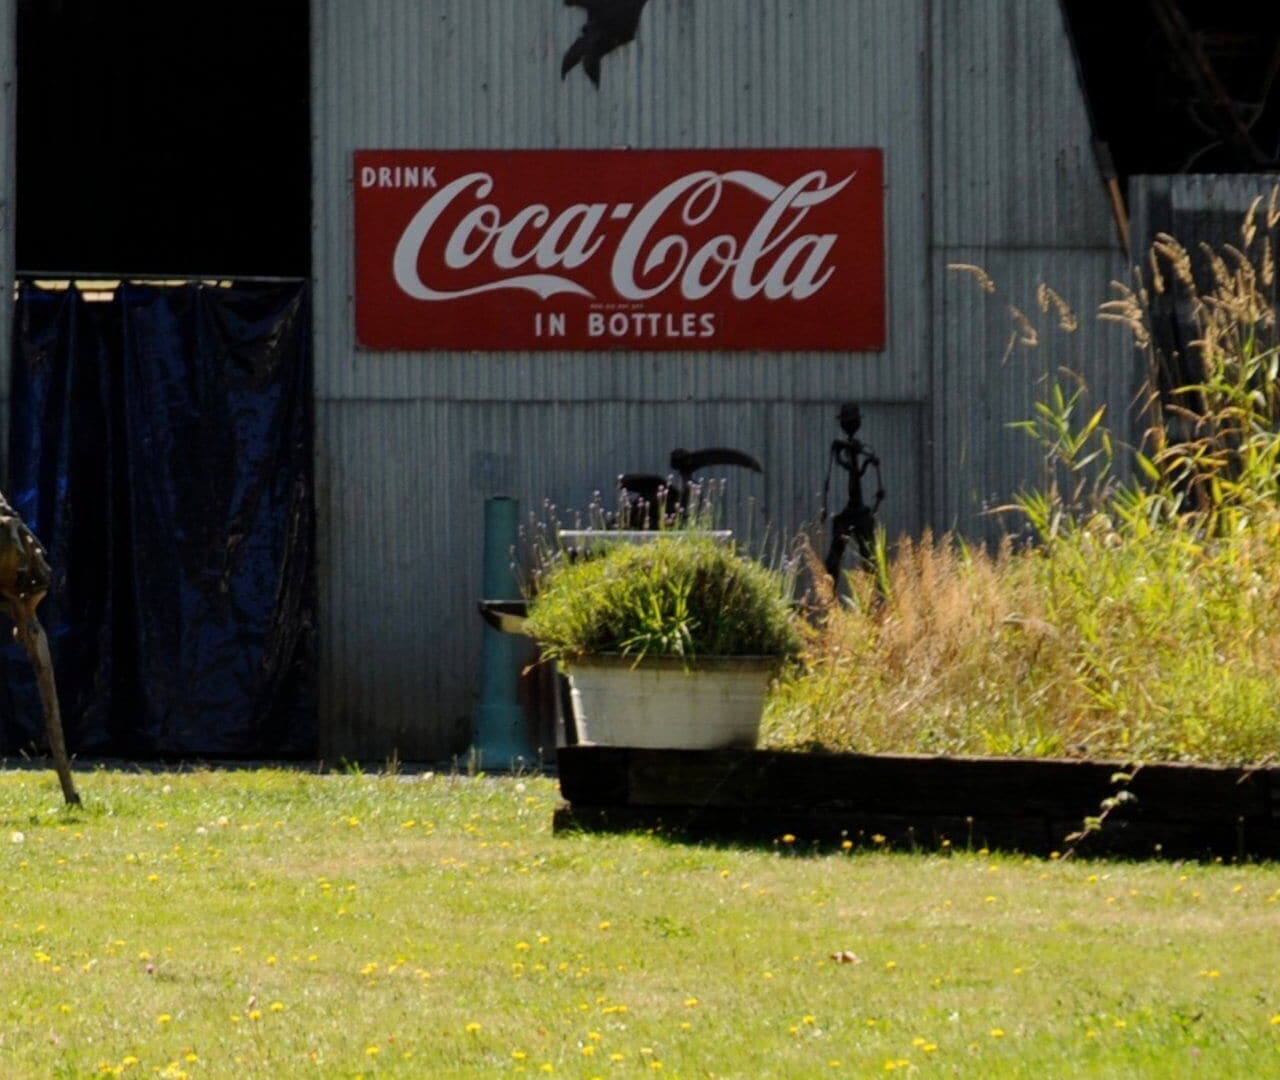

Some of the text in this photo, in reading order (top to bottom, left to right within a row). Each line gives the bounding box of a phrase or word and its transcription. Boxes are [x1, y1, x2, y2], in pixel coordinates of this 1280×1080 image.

[361, 166, 438, 189] DRINK
[392, 169, 858, 301] Coca-Cola
[534, 312, 716, 338] IN BOTTLES
